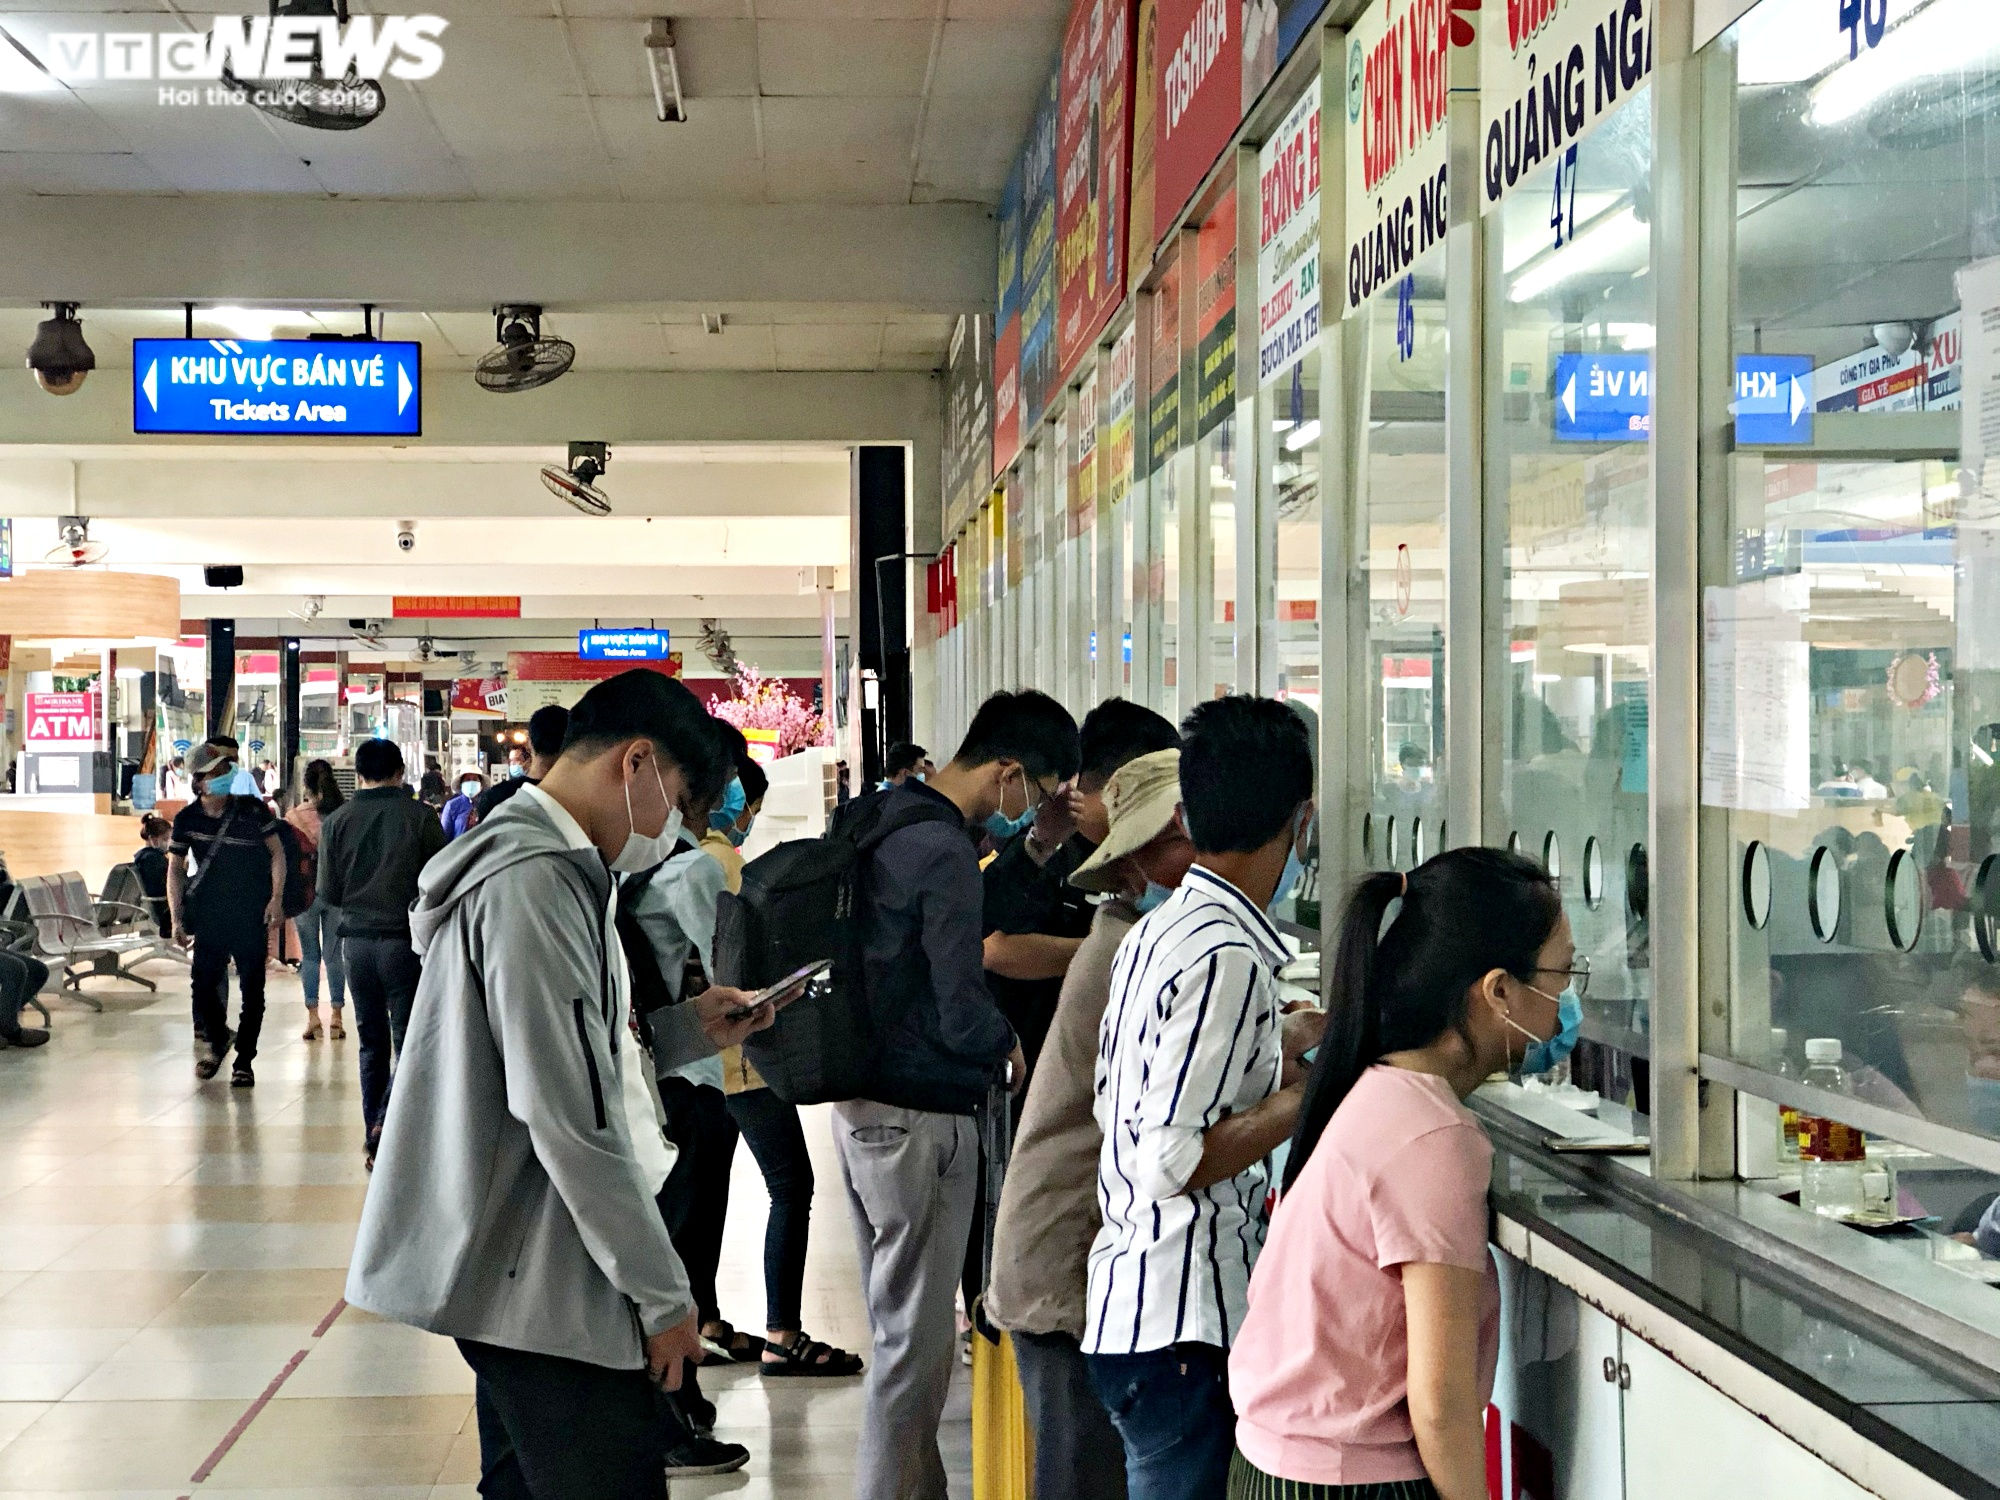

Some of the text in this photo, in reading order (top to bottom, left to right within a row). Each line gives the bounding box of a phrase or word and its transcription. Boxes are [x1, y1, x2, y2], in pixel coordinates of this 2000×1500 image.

[1165, 0, 1226, 140] TOSHIBA
[1486, 0, 1652, 201] QUẢNG NG
[1262, 136, 1305, 248] HỒNG
[1551, 142, 1578, 249] 47
[1350, 197, 1414, 308] QUẢNG
[1261, 279, 1293, 335] PLEIKU
[1301, 257, 1315, 299] AN
[1397, 272, 1415, 363] 46
[231, 354, 287, 392] VỰC
[293, 353, 346, 386] BÁN
[351, 354, 384, 387] VÉ
[1261, 331, 1285, 379] BUÔN
[1287, 318, 1302, 357] MA
[1304, 302, 1320, 341] TH
[1859, 362, 1867, 379] TY
[1869, 357, 1880, 375] GIA
[1931, 328, 1961, 371] XU
[210, 399, 347, 421] Tickets Area
[1862, 383, 1876, 402] GIÁ
[30, 716, 90, 737] ATM
[488, 693, 505, 707] BIA
